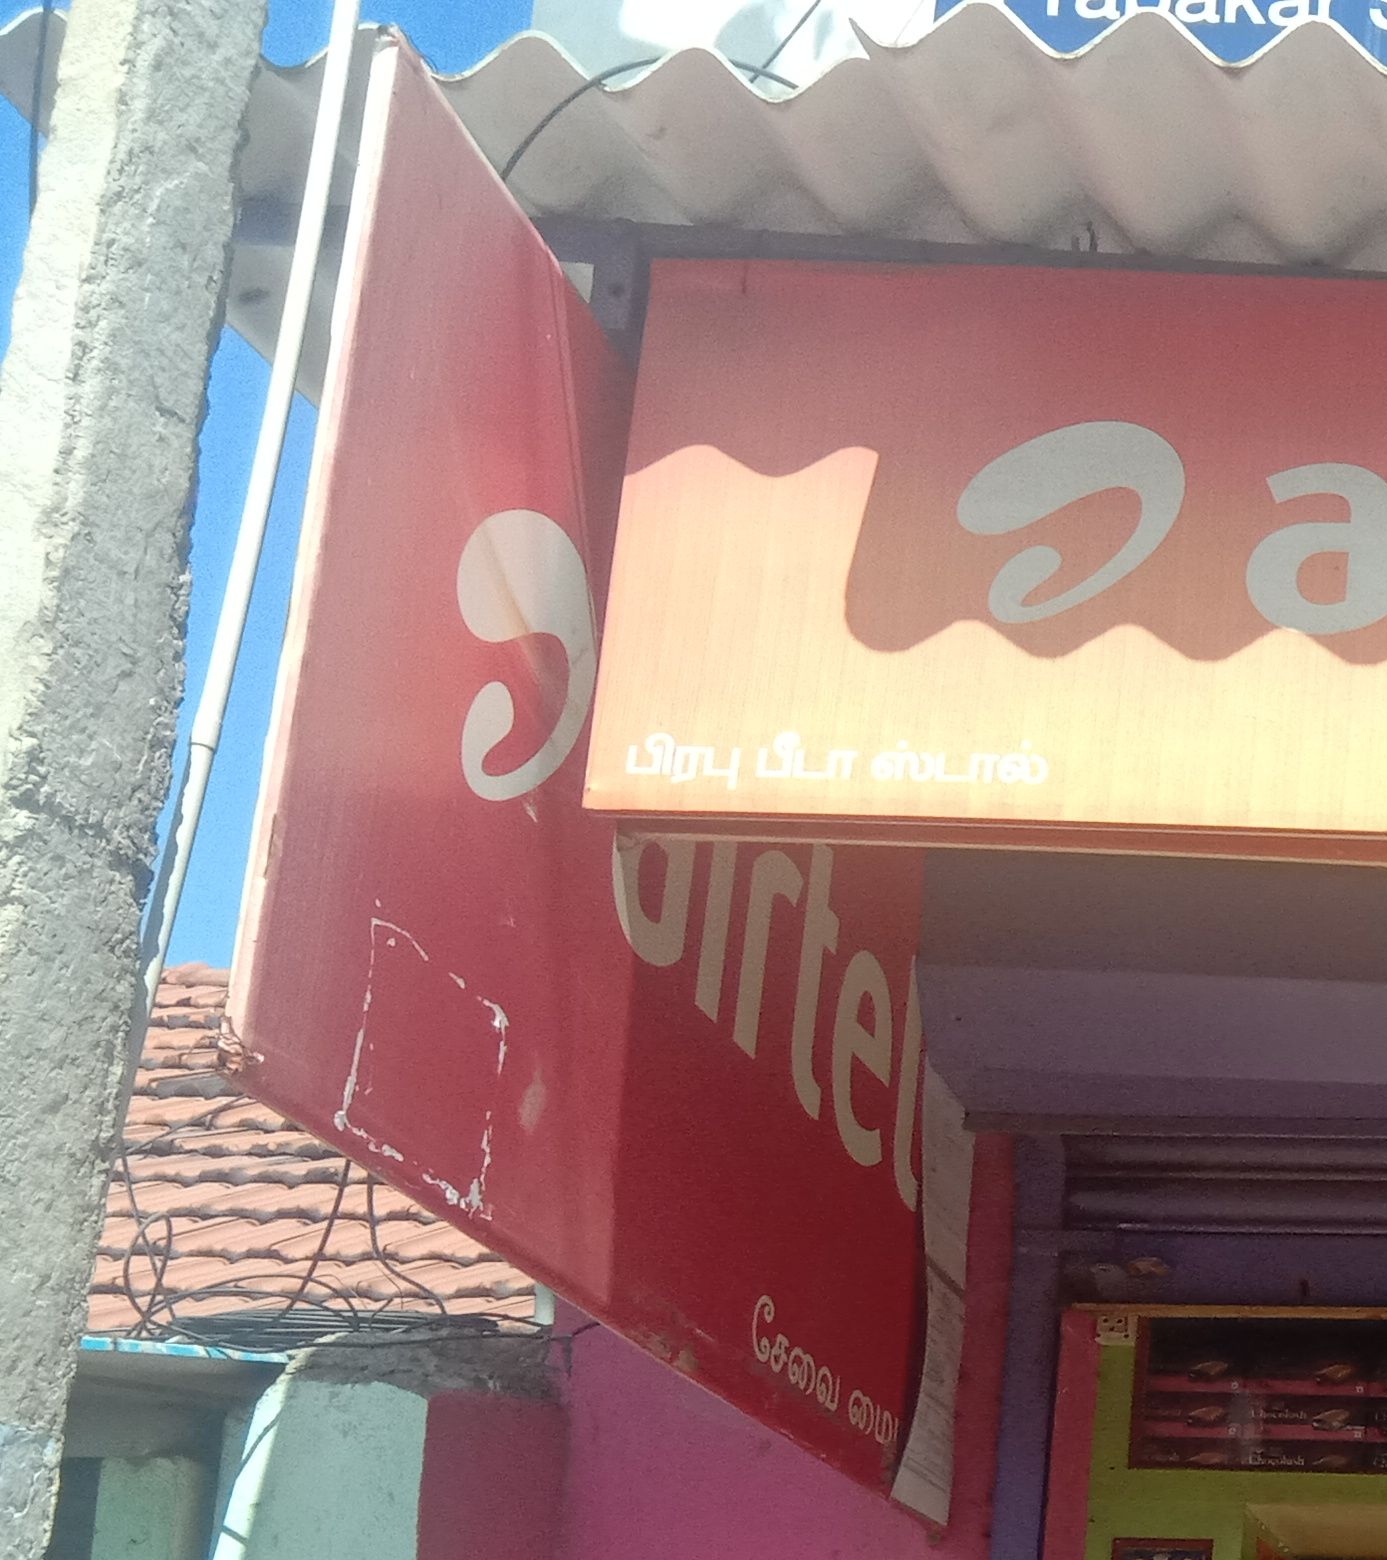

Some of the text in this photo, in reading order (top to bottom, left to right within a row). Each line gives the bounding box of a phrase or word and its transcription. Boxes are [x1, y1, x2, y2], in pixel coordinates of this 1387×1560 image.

[624, 730, 1049, 790] பிரபு பீடா ஸ்டால்
[612, 839, 926, 1213] airtel
[752, 1294, 900, 1444] சேவை மை
